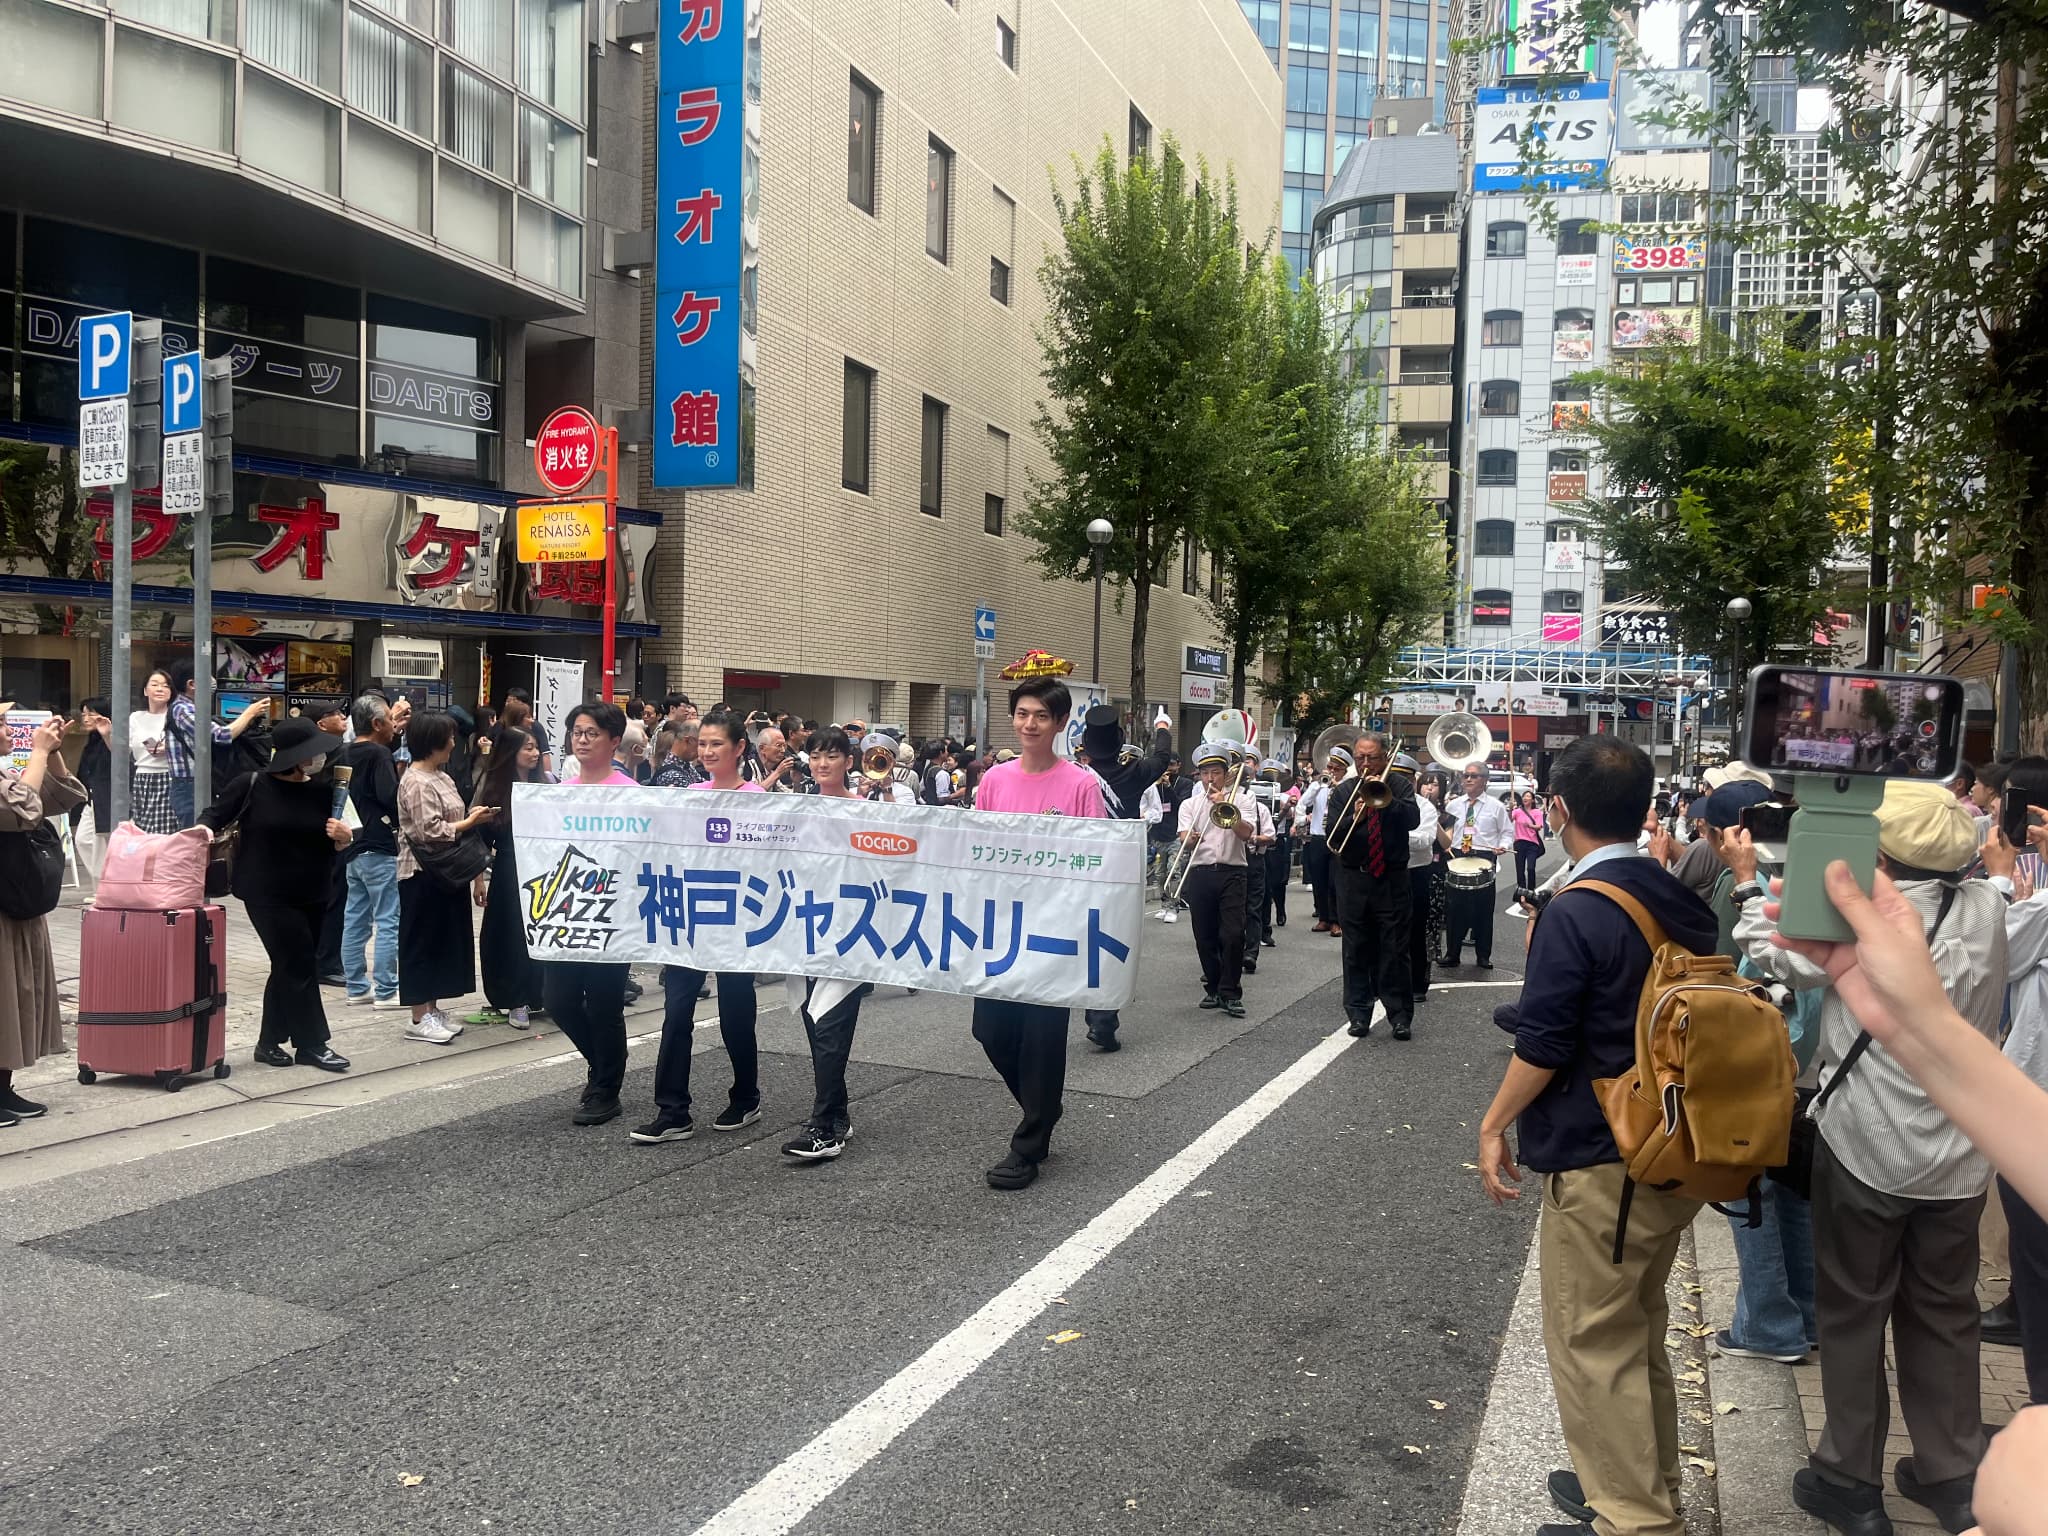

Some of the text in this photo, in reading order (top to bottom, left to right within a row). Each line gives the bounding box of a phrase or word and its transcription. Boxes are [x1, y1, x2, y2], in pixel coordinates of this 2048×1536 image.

[1491, 109, 1520, 119] OSAKA
[1489, 119, 1598, 144] AXIS
[670, 0, 724, 447] カラオケ館
[92, 323, 121, 390] P
[221, 343, 343, 395] ダーツ
[172, 363, 194, 425] P
[370, 371, 492, 421] DARTS
[545, 426, 590, 439] FIRE HYDRANT
[545, 443, 589, 472] 消火栓
[83, 461, 125, 481] ここまで
[165, 492, 201, 509] ここから
[543, 511, 576, 522] HOTEL
[530, 523, 591, 539] RENAISSA
[1189, 684, 1211, 699] docomo
[709, 822, 728, 833] 133
[856, 834, 910, 852] TOCALO
[972, 844, 1104, 871] サンシティタワー神戸
[563, 864, 621, 895] KOBE
[525, 924, 622, 951] STREET
[636, 862, 1131, 989] 神戸ジャズストリート
